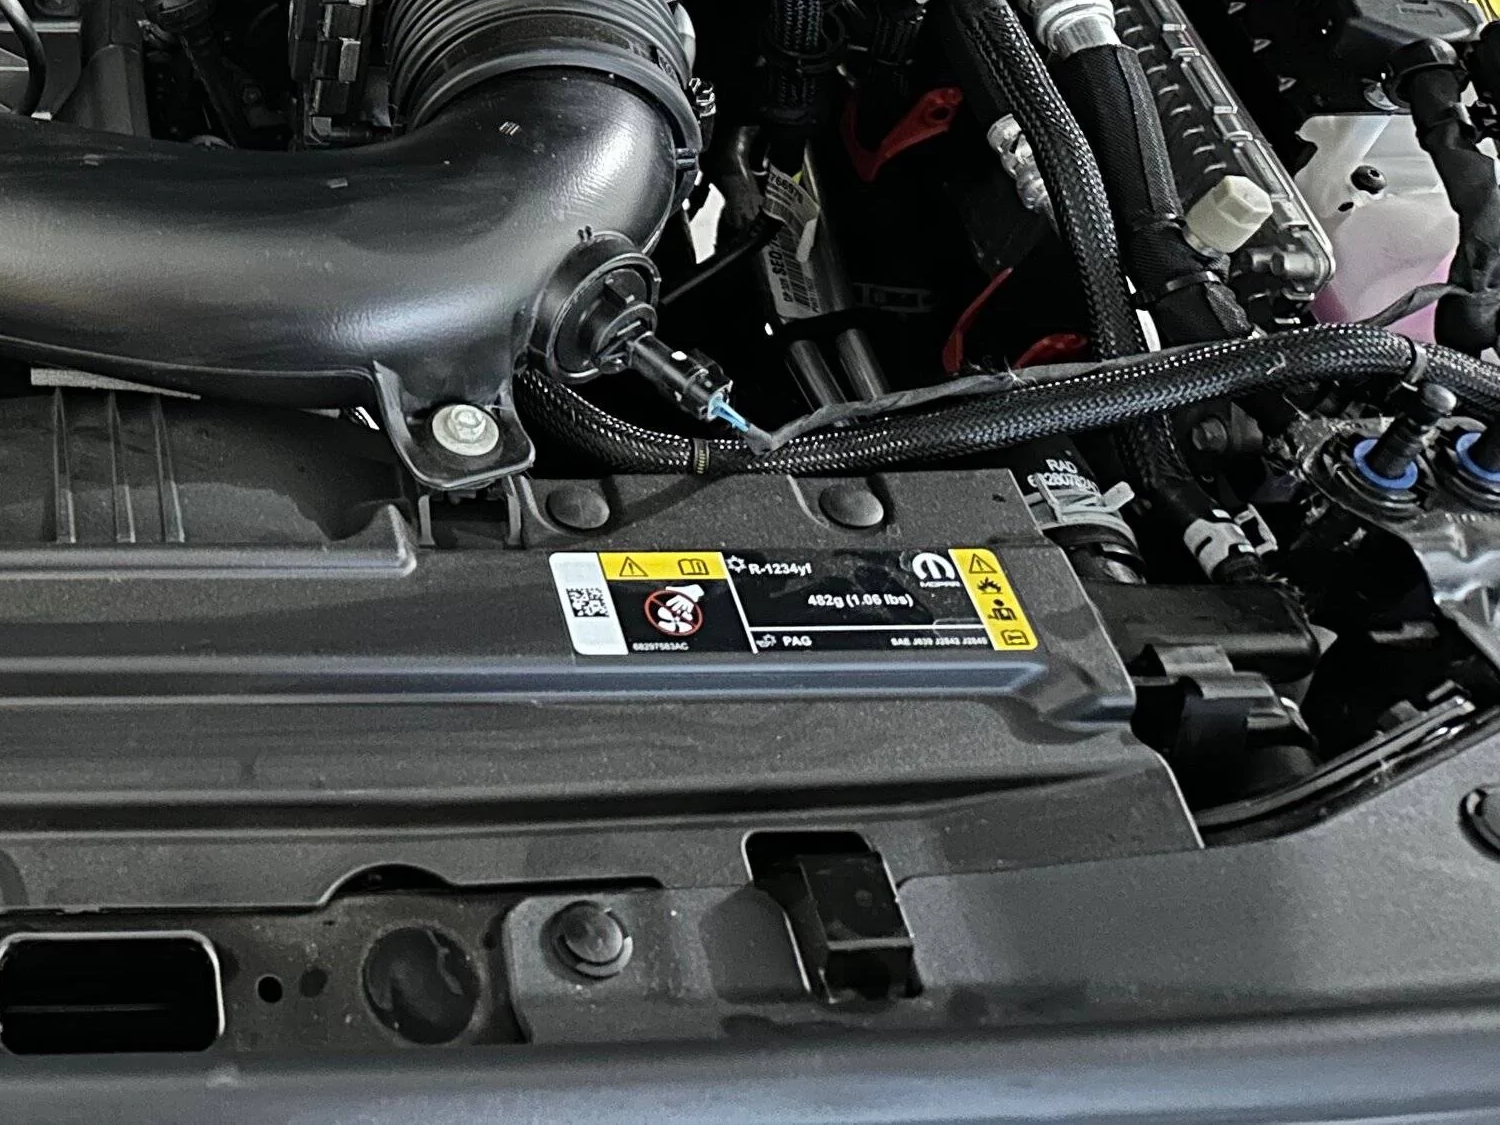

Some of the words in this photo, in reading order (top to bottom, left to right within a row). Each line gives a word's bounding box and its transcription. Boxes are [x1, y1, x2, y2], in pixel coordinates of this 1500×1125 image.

[1045, 458, 1078, 474] RAD
[807, 594, 845, 608] 482g
[846, 594, 883, 608] (1.06
[884, 593, 914, 607] lbs)
[782, 635, 812, 647] PAG
